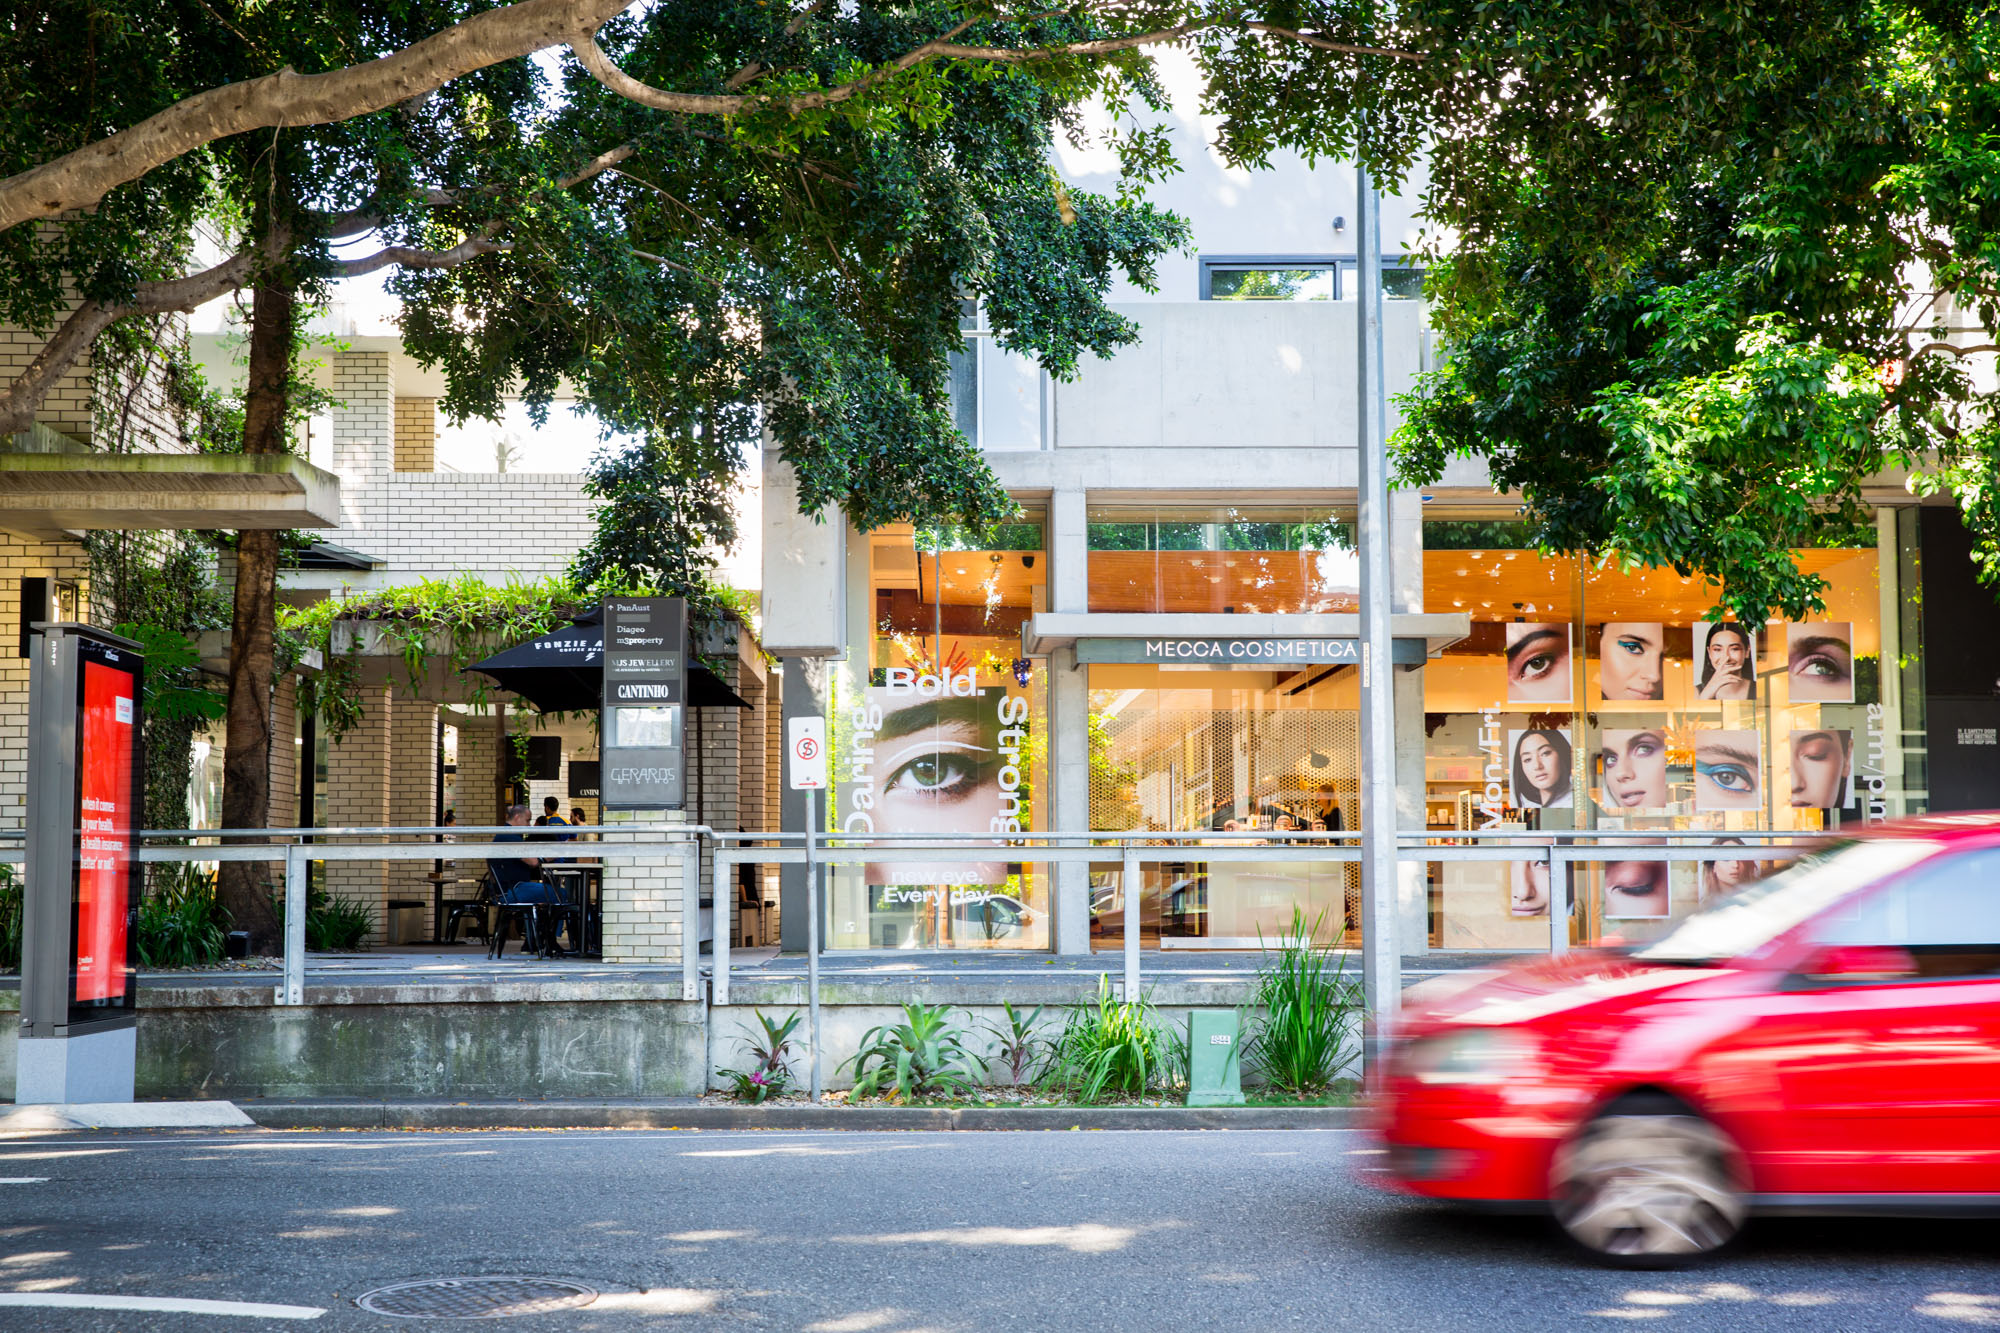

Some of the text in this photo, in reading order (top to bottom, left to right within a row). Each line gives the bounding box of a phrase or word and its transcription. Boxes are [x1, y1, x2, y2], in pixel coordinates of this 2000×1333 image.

[616, 603, 651, 612] PanAust
[616, 625, 646, 635] Diageo
[534, 640, 588, 650] FONZIE
[616, 637, 664, 646] m3property
[1146, 641, 1358, 657] MECCA COSMETICA
[628, 659, 676, 667] JEWELLERY
[885, 666, 986, 697] Bold.
[618, 684, 669, 698] CANTINHO
[844, 696, 883, 844] Daring.
[942, 870, 984, 886] eye.
[884, 887, 991, 906] Every day.
